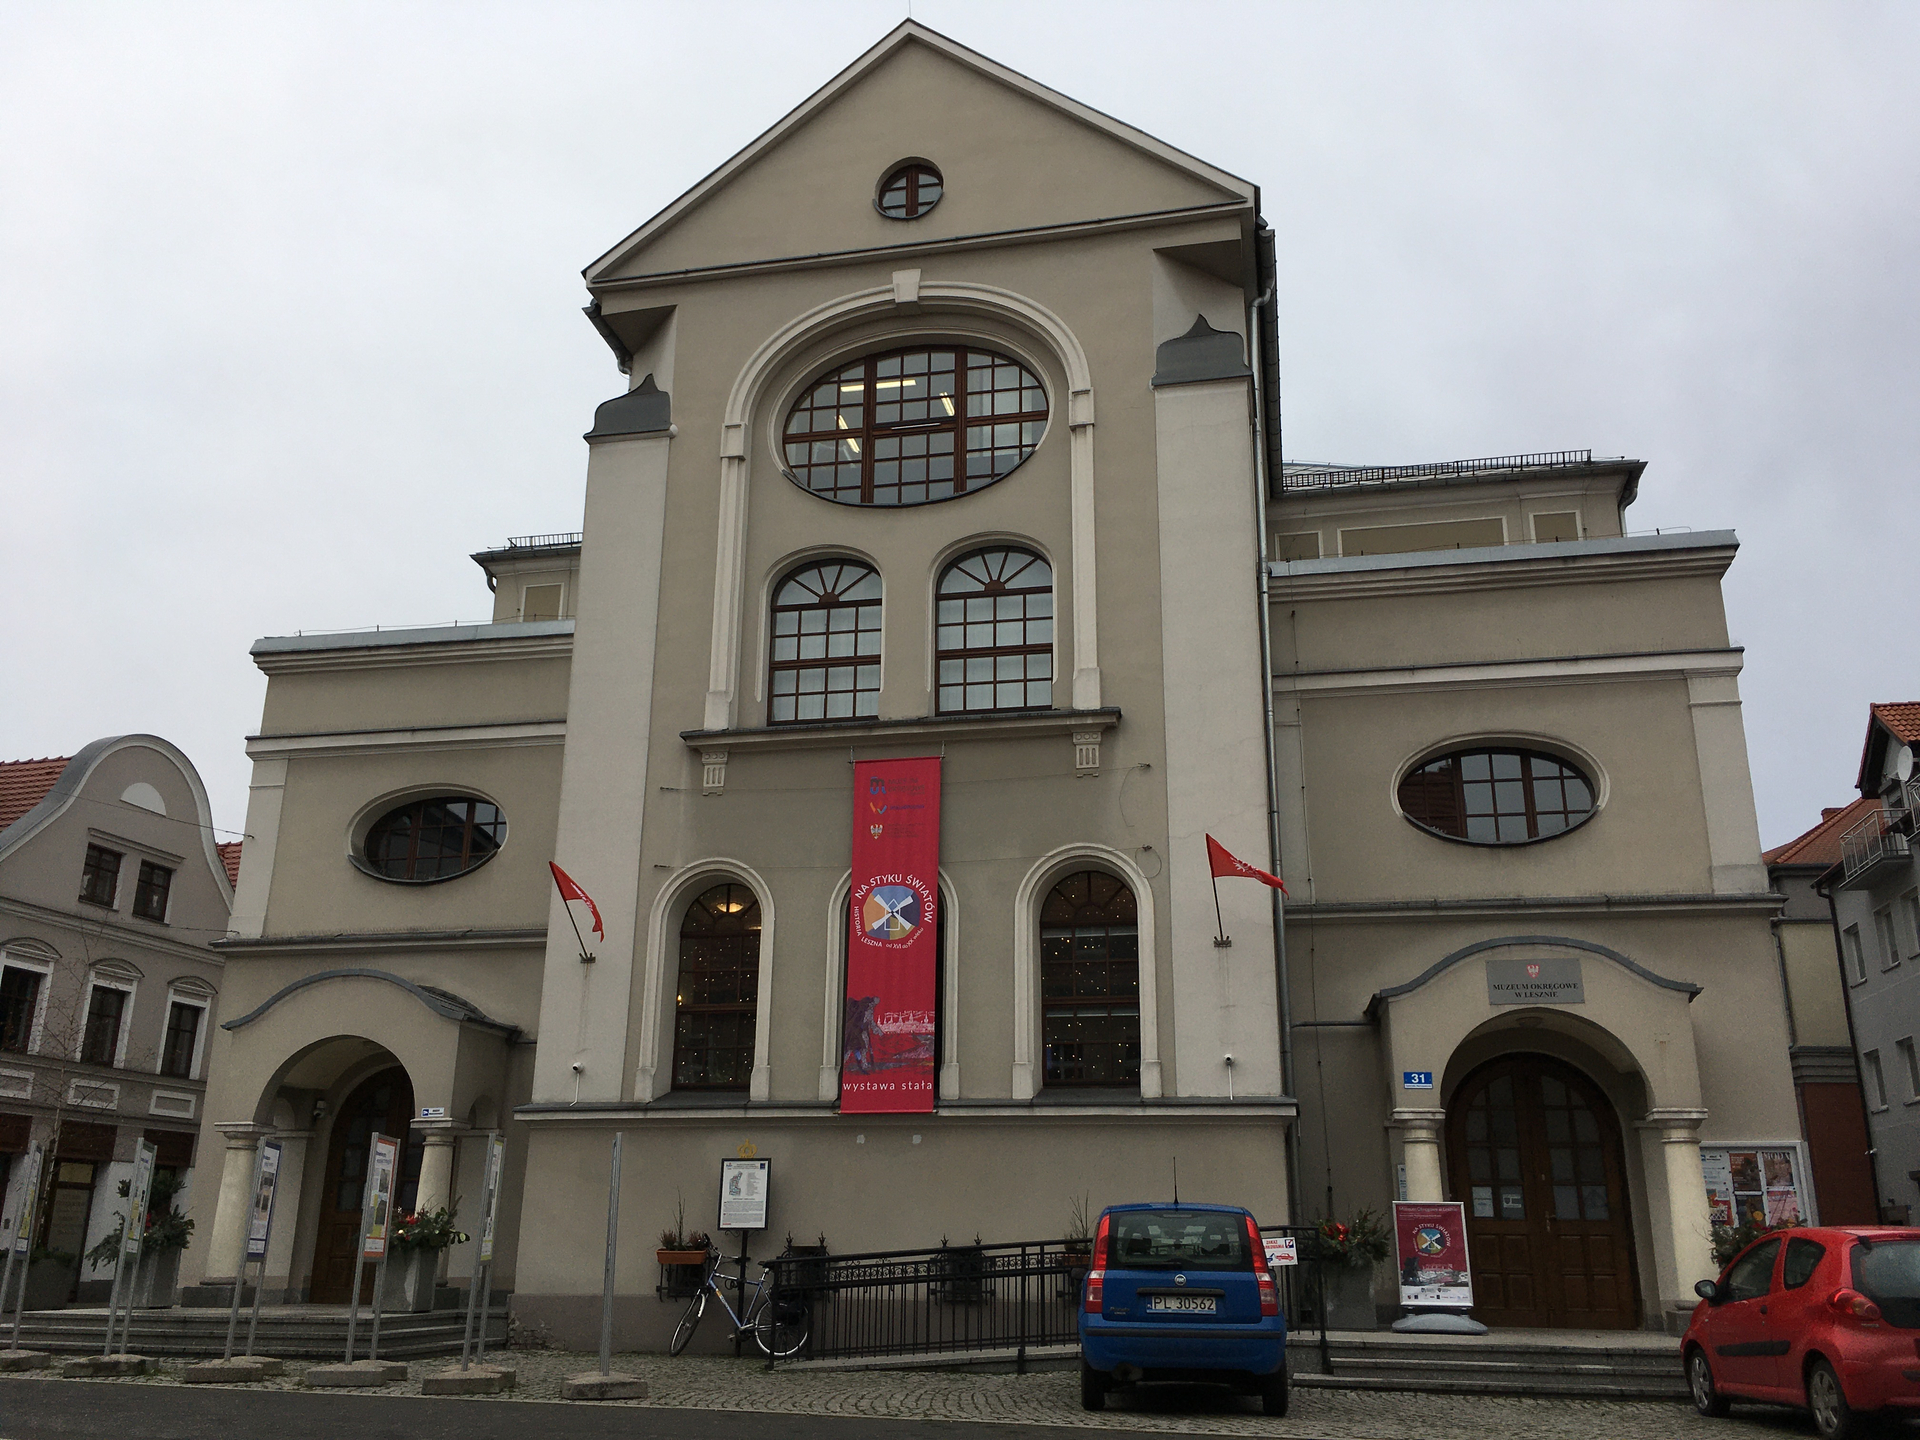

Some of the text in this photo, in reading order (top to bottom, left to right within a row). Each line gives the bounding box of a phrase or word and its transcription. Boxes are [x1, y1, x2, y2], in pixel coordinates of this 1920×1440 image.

[855, 874, 936, 923] NA STYKU ŚWIATÓW
[854, 906, 883, 947] HISTORIA LESZNA
[1493, 982, 1579, 991] MUZEUM OKRĘGOWE
[1411, 1073, 1425, 1083] 31
[843, 1080, 933, 1092] wystawa stała
[1154, 1297, 1215, 1311] PL 30562
